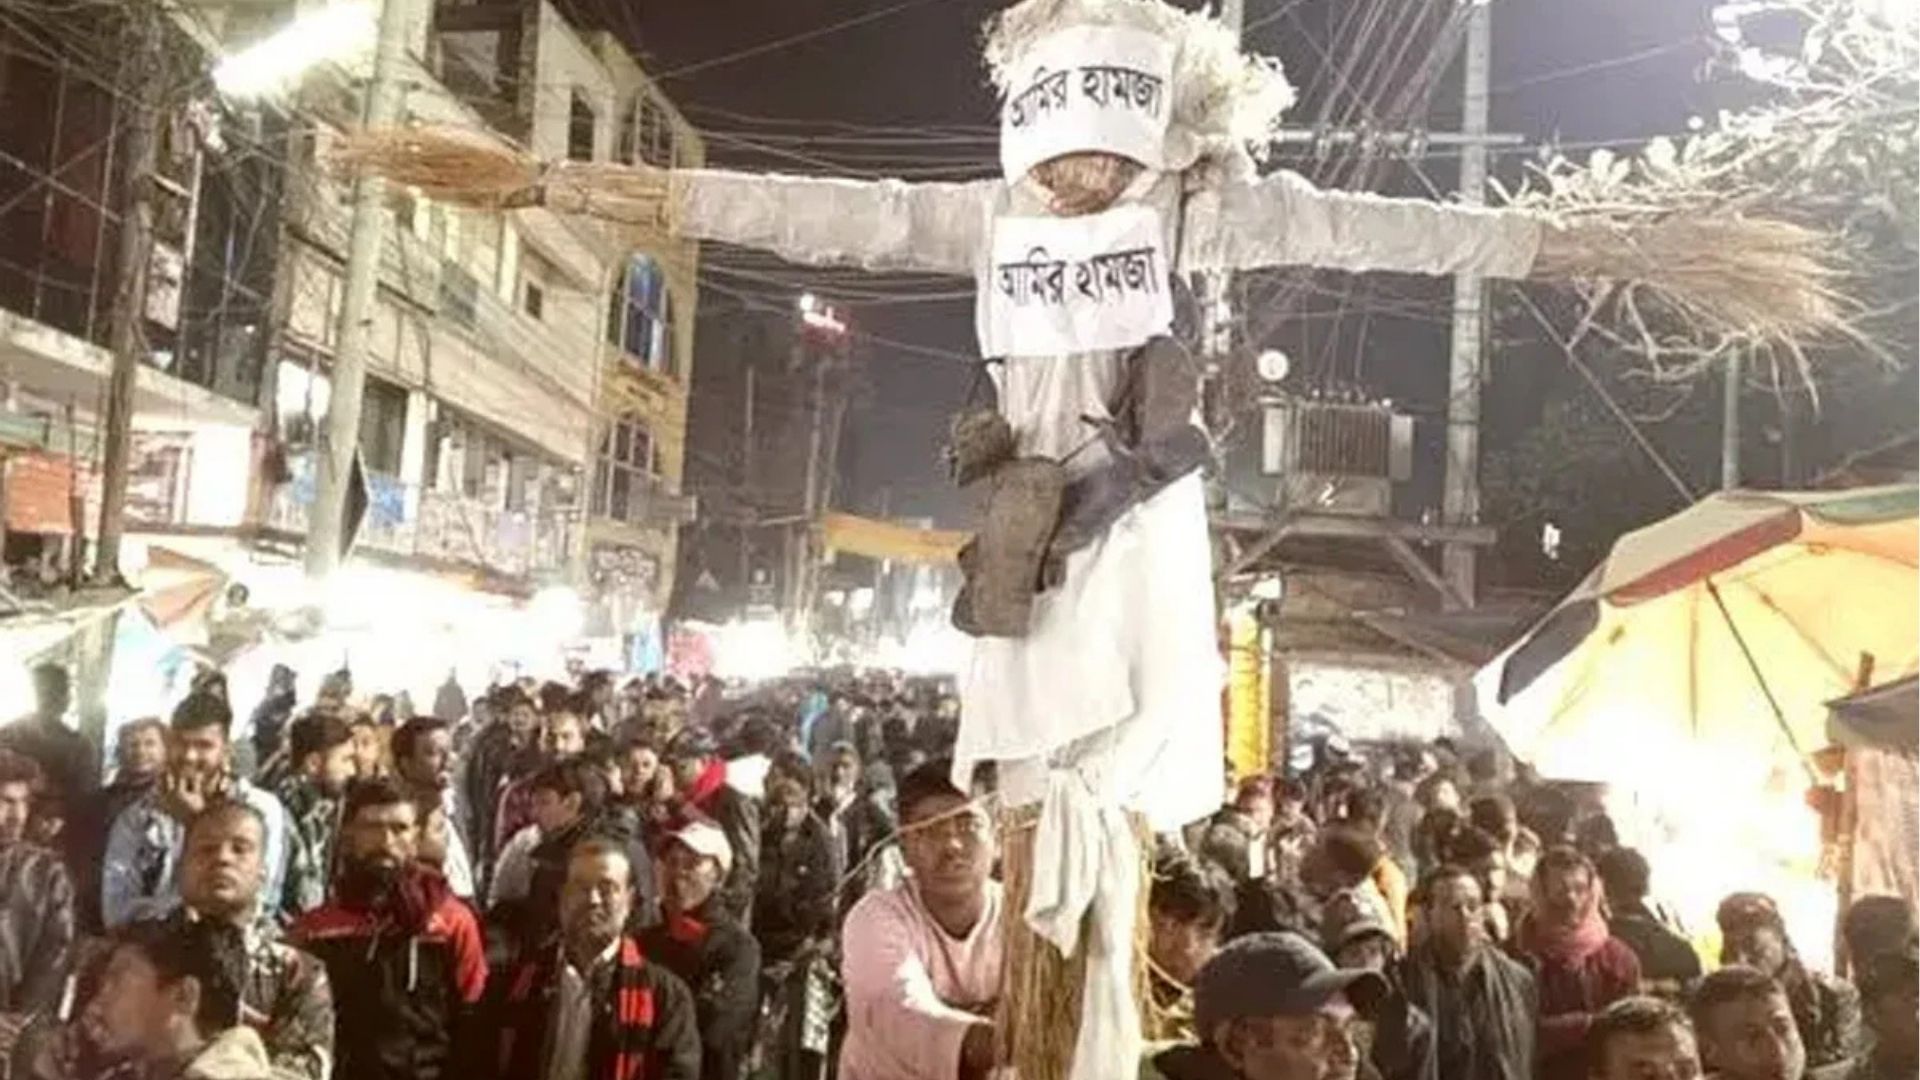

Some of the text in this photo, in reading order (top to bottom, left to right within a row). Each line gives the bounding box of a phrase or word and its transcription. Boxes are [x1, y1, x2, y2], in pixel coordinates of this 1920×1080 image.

[1079, 66, 1163, 121] হামজা
[998, 246, 1159, 307] আমির হামজা
